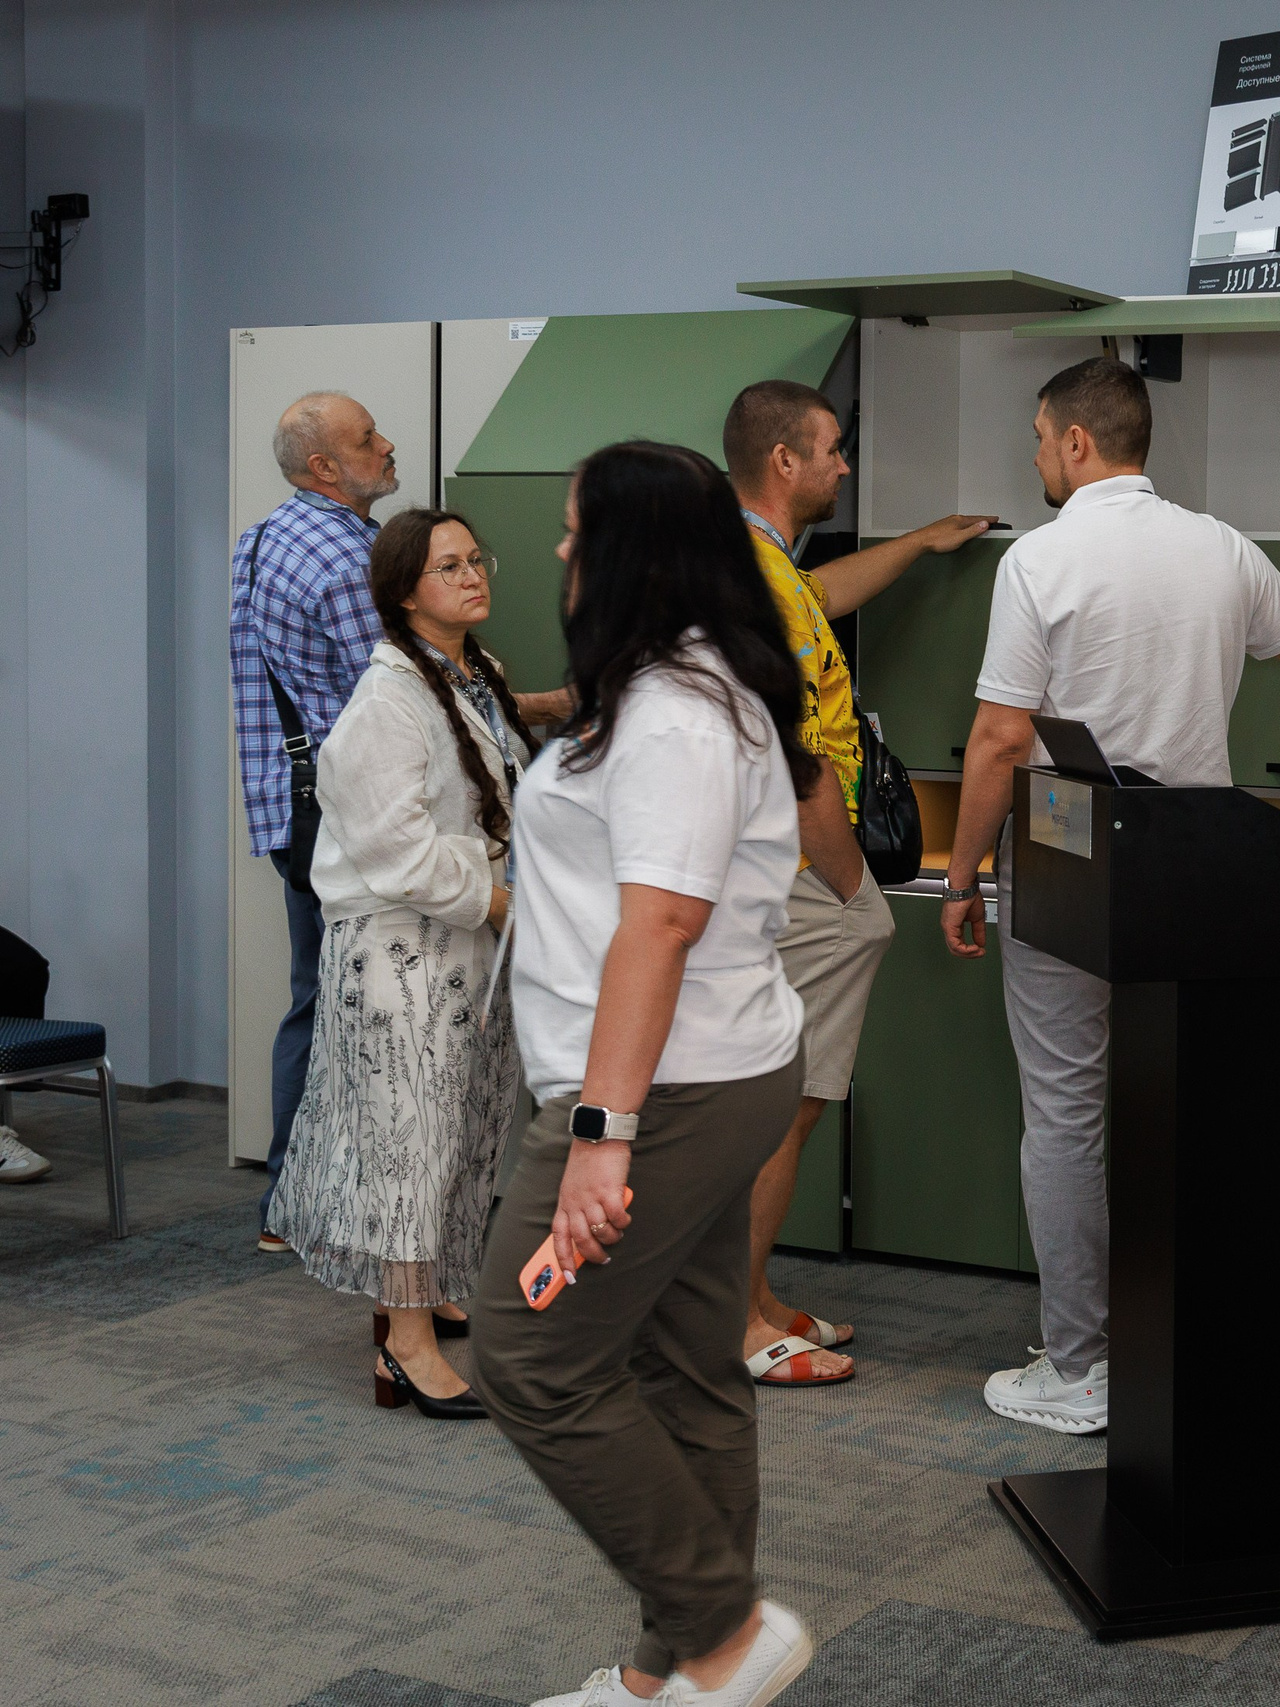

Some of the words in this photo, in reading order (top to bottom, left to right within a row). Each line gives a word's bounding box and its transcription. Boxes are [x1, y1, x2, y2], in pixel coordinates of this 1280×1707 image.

[1240, 53, 1272, 64] Система
[1238, 61, 1271, 73] профилей
[1236, 74, 1280, 89] Доступные
